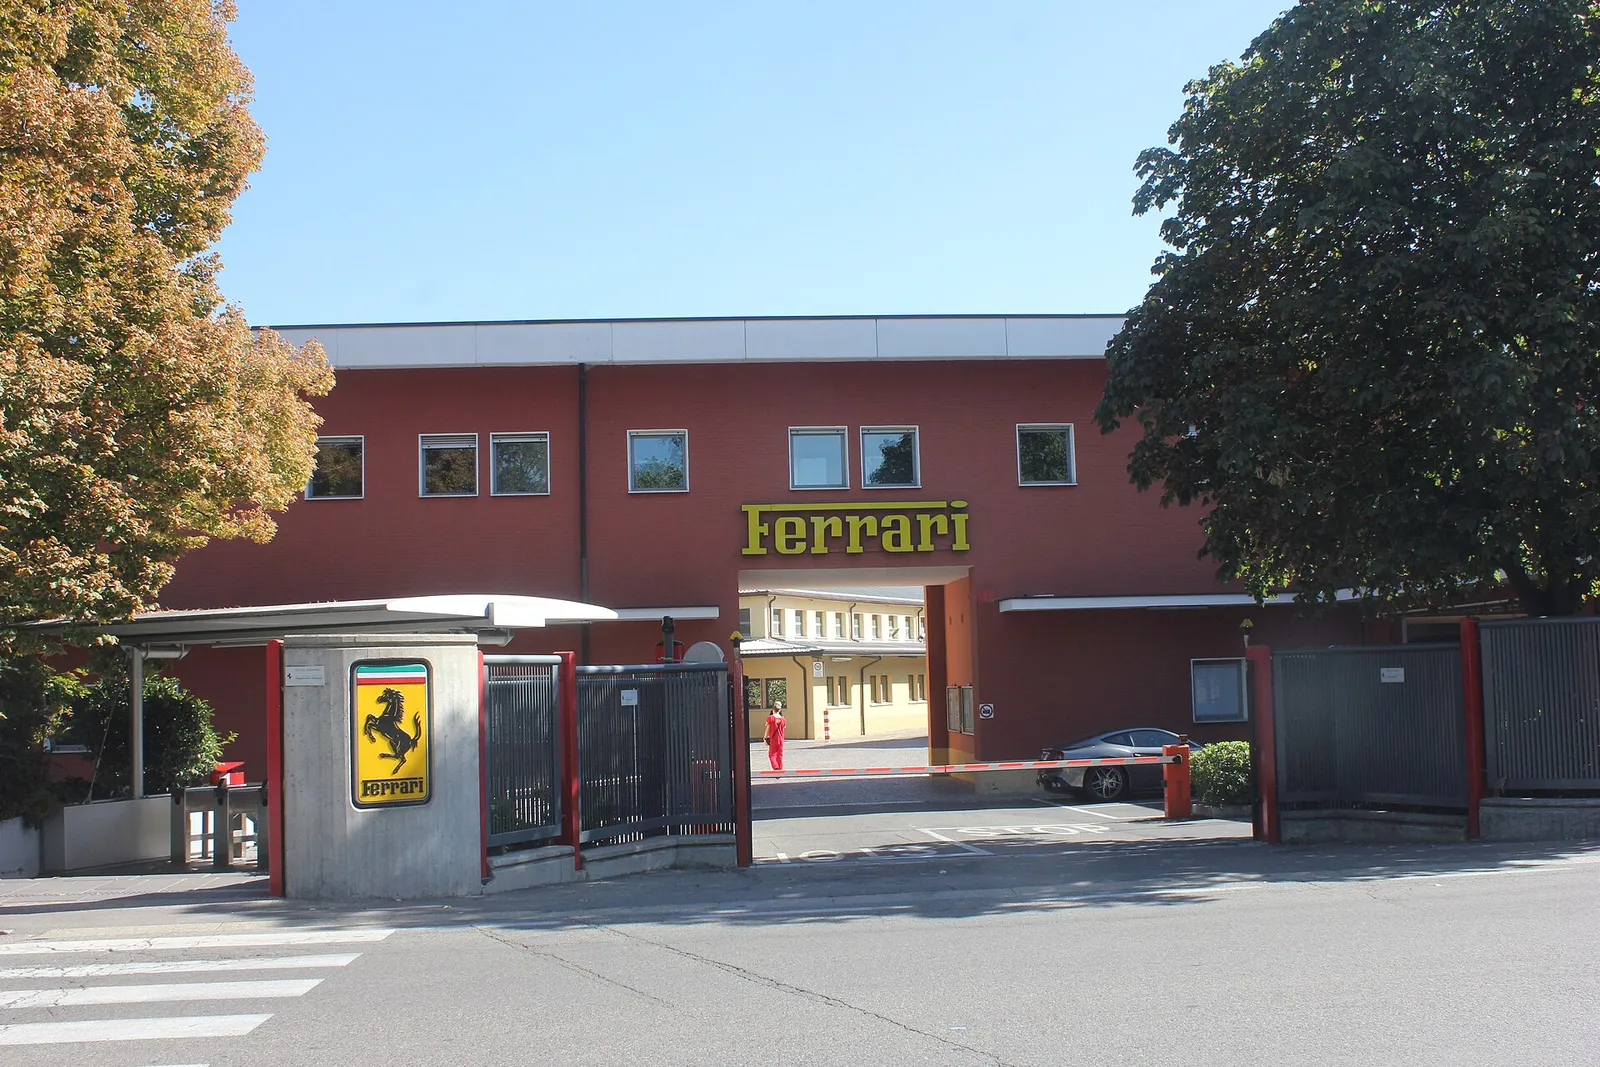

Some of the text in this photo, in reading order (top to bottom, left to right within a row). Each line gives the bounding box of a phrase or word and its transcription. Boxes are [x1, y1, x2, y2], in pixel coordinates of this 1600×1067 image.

[741, 500, 970, 555] Ferrari
[362, 777, 424, 796] Ferrari
[957, 824, 1111, 837] STOP
